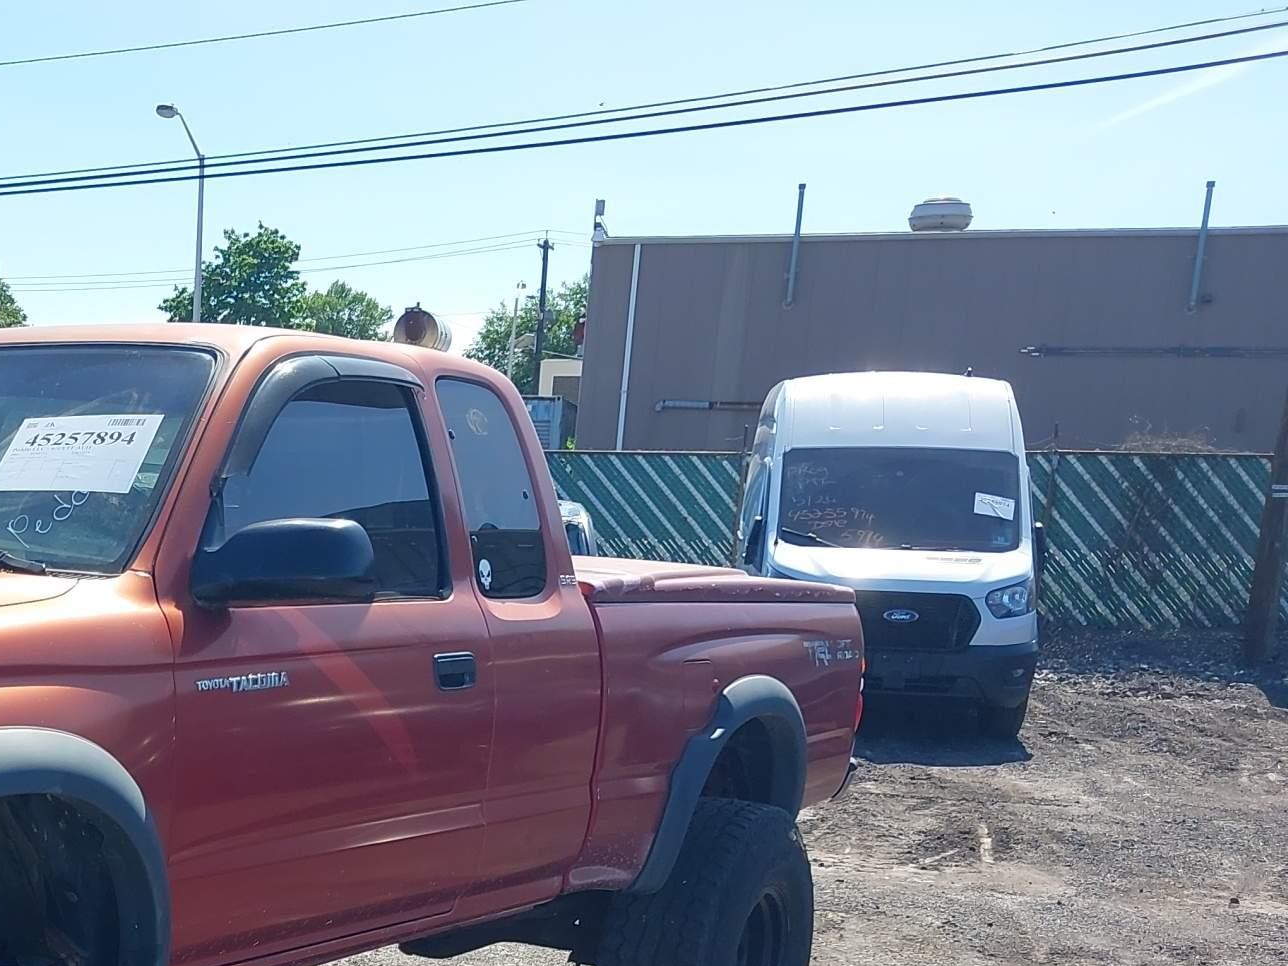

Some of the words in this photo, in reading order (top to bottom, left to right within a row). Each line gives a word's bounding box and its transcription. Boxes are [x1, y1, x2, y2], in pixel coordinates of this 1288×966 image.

[25, 430, 138, 447] 45257894
[195, 678, 230, 692] TOYOTA
[229, 671, 290, 693] TACOMA
